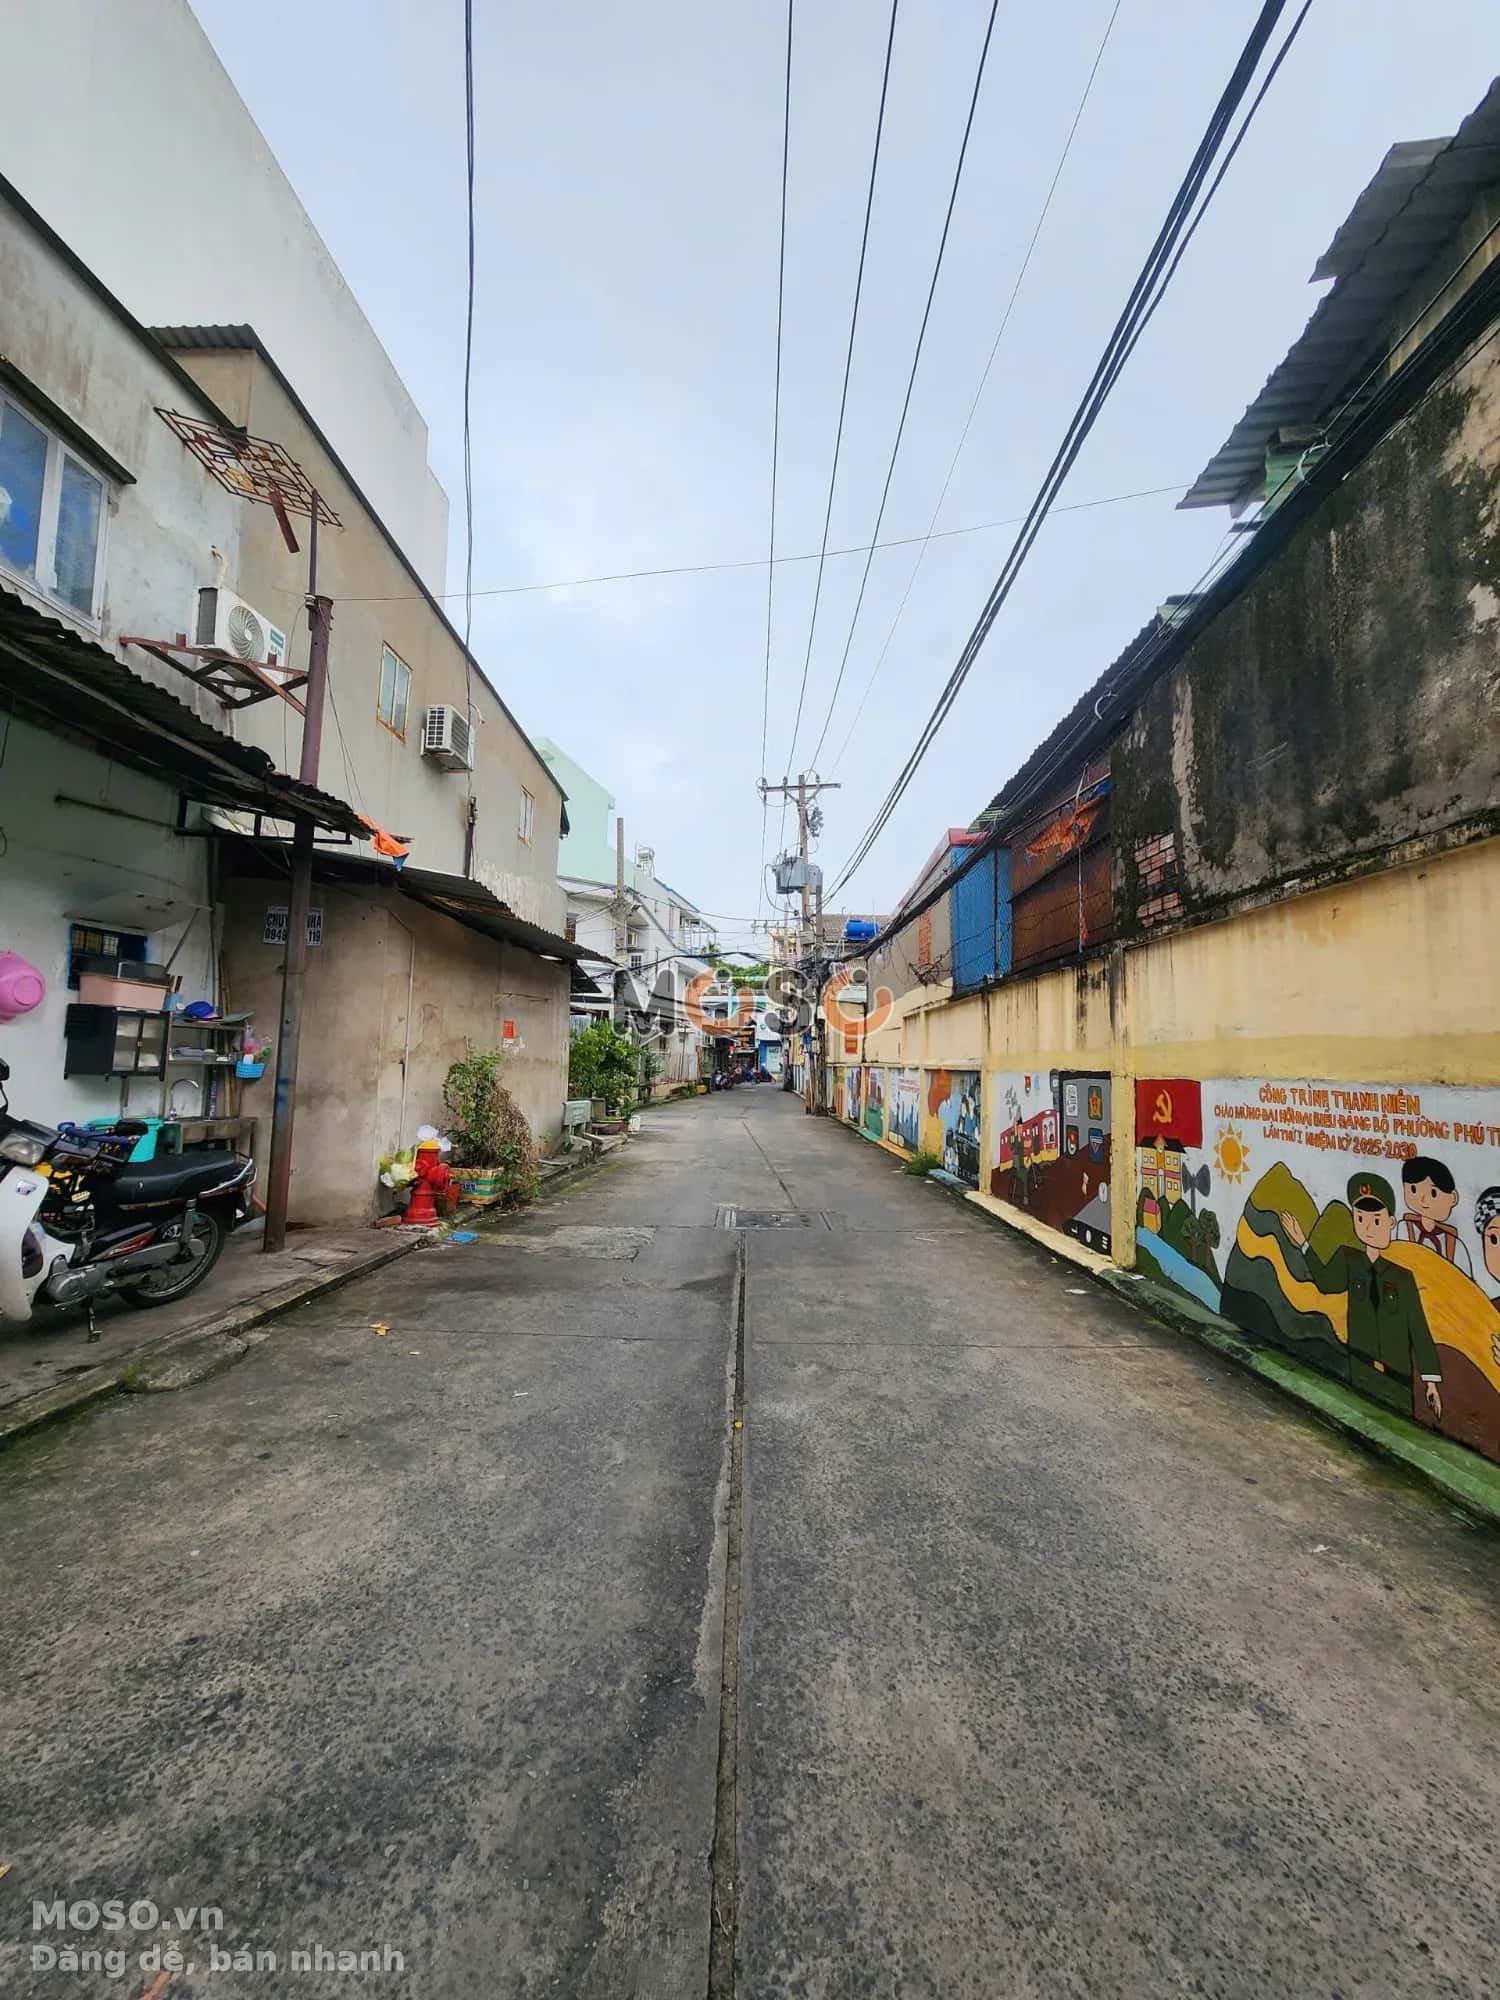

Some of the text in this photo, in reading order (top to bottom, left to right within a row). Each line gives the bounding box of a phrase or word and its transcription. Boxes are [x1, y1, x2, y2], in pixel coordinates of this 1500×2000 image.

[1259, 1082, 1421, 1116] CÔNG TRÌNH THANH NIÊN
[1393, 1115, 1450, 1140] PHƯỜNG
[1453, 1121, 1485, 1145] PHÚ
